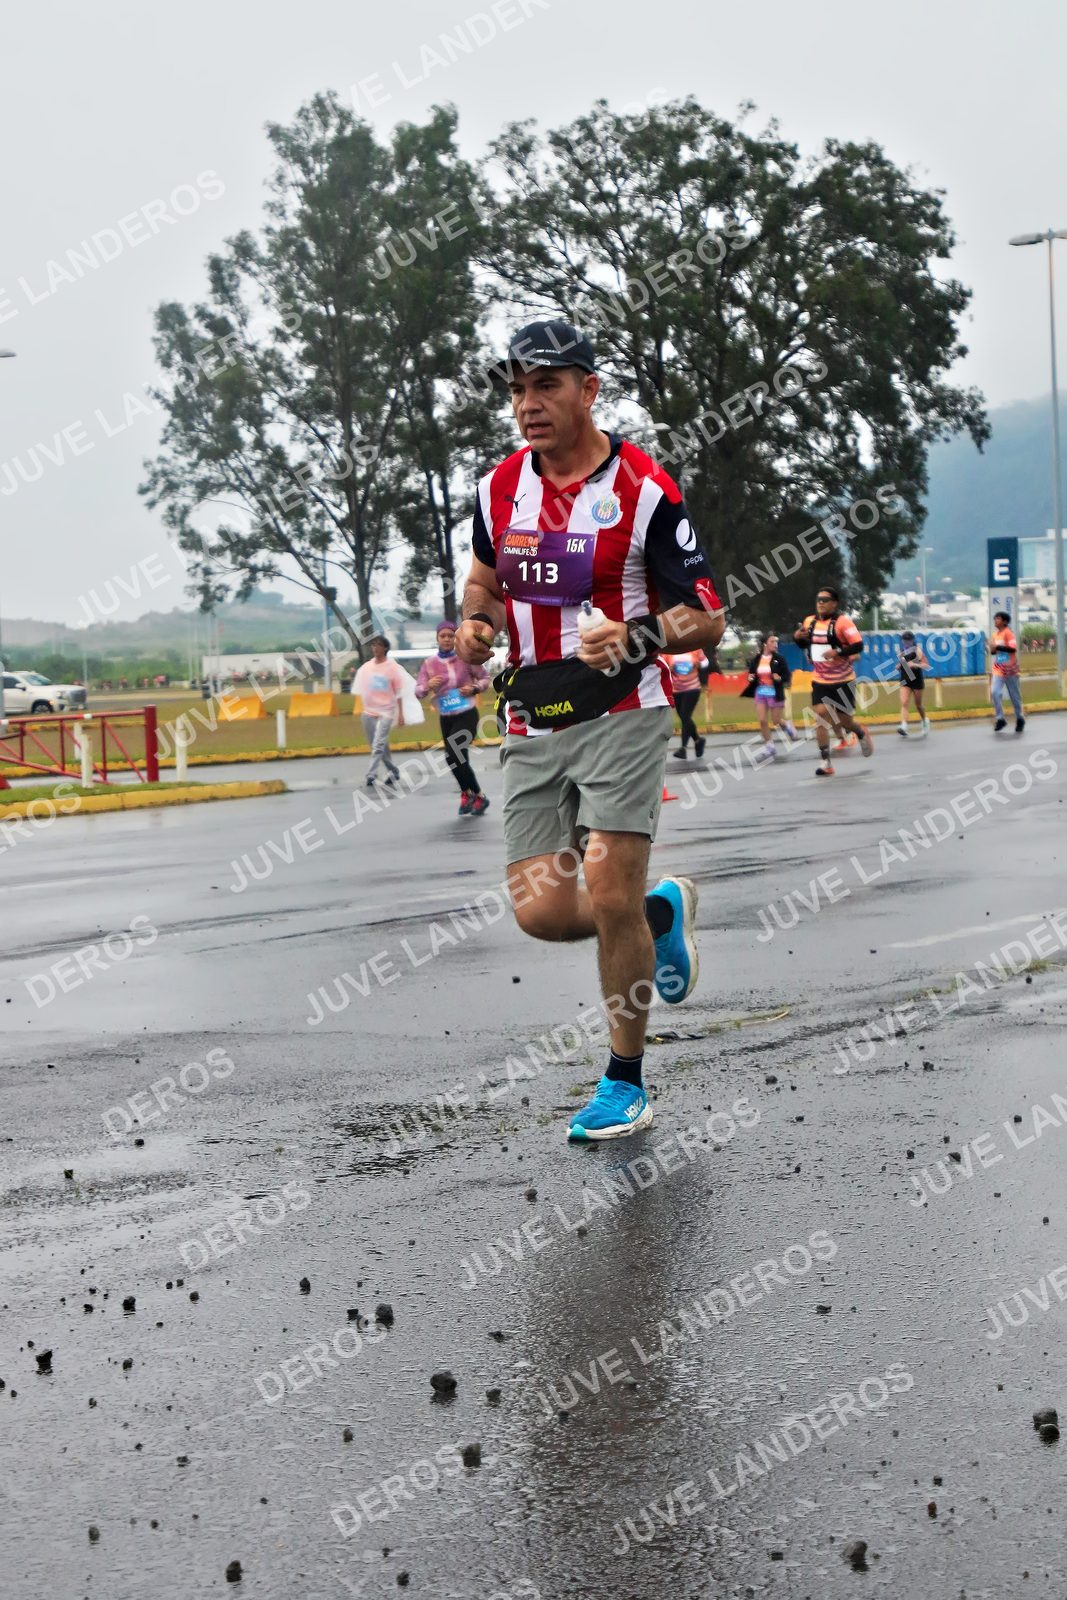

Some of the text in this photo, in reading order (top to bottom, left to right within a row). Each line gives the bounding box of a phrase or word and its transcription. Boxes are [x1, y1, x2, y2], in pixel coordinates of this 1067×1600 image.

[518, 561, 558, 584] 113
[993, 558, 1010, 581] E
[534, 700, 574, 717] HOKA
